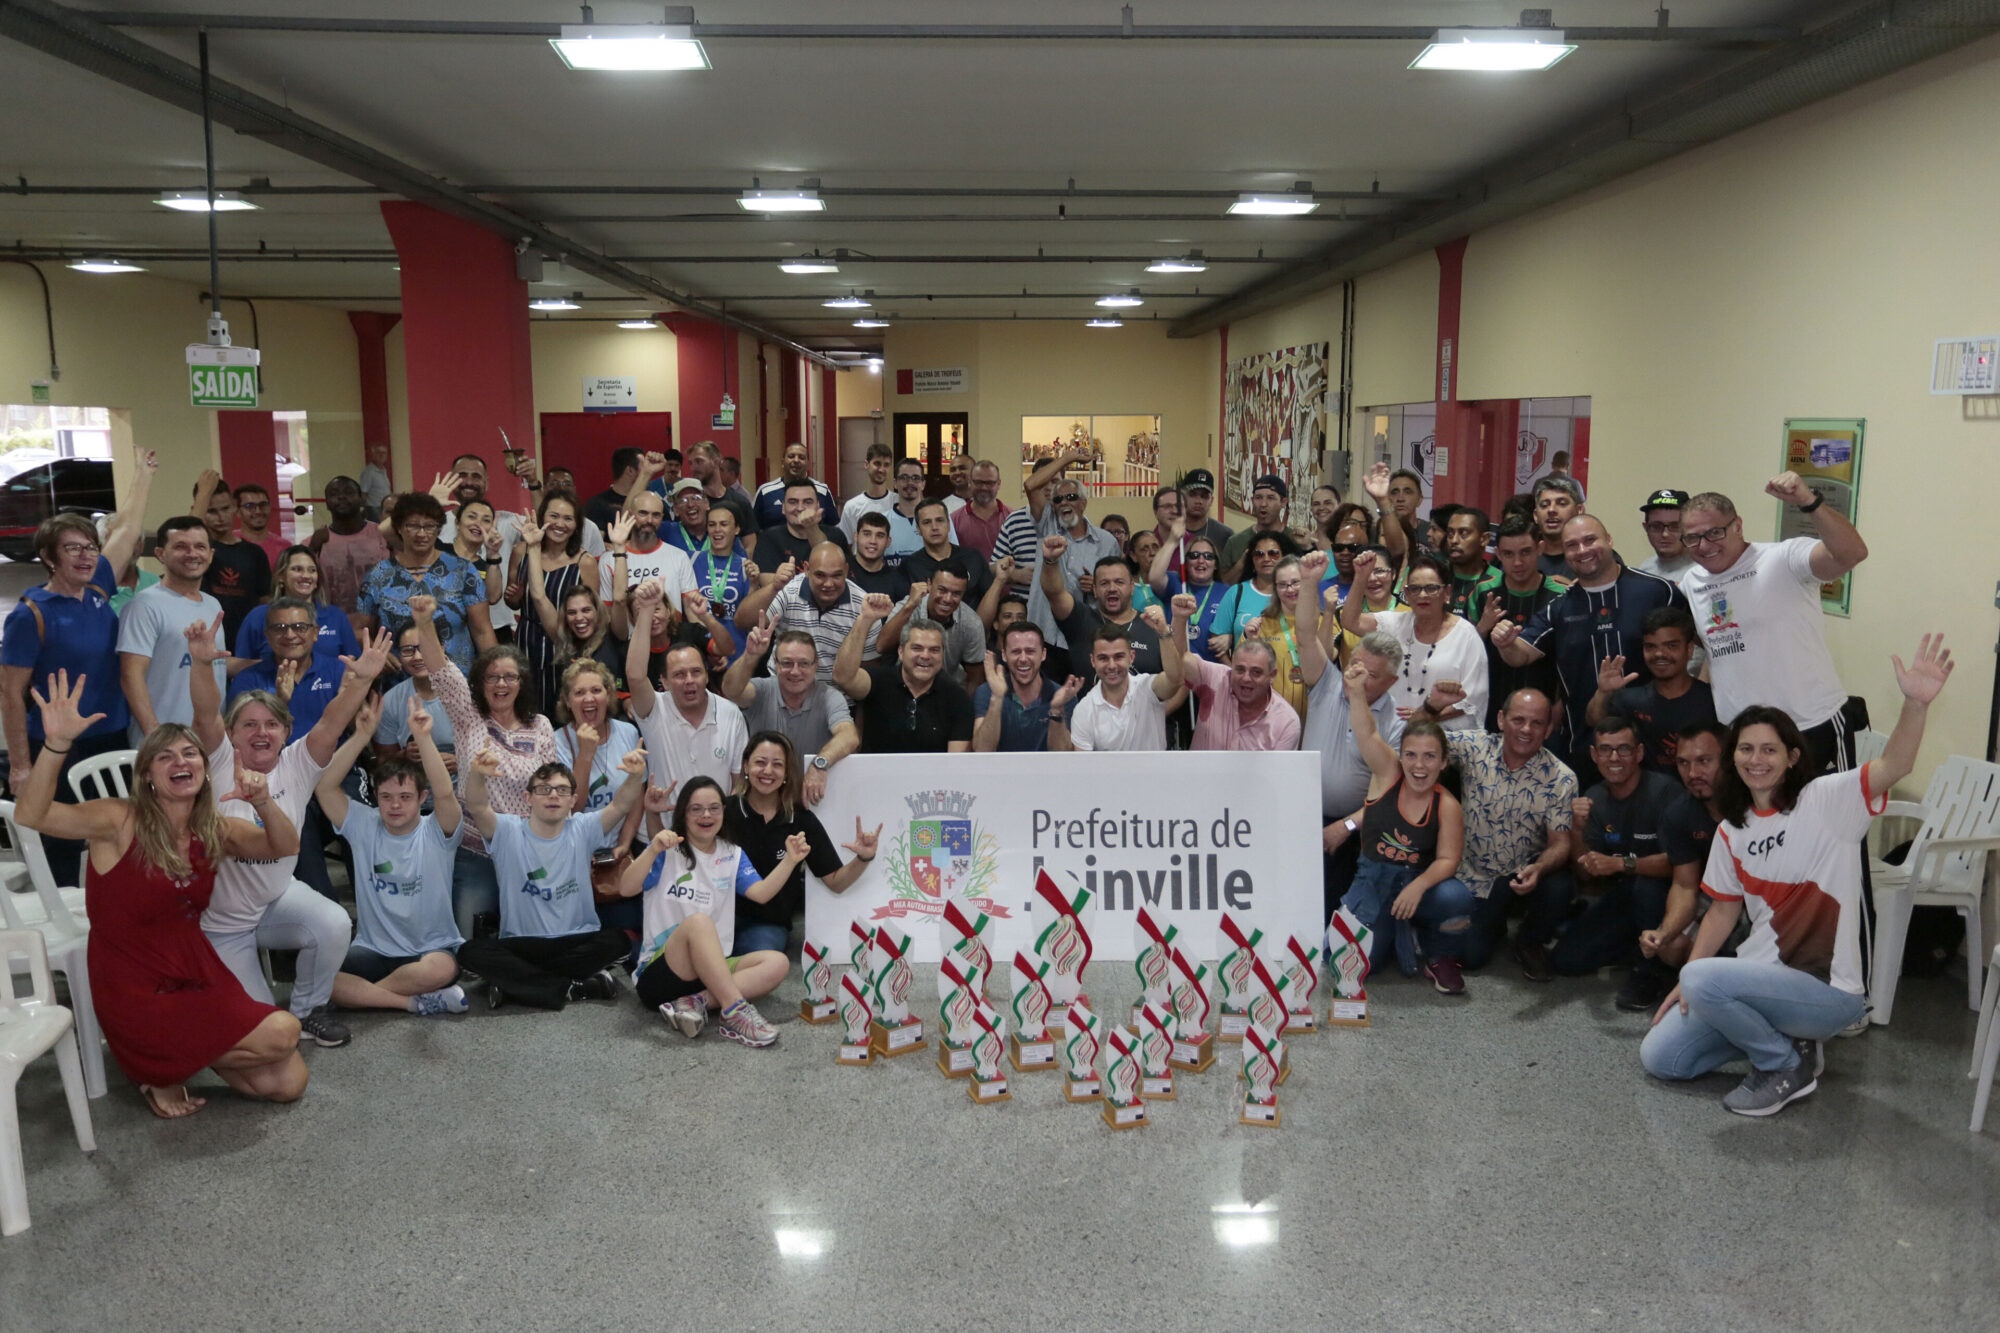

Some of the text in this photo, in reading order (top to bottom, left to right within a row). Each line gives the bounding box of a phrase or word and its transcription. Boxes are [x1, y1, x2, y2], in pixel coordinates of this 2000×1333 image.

[193, 366, 255, 398] SAÍDA
[1710, 641, 1745, 659] Joinville
[1032, 808, 1252, 848] Prefeitura de
[521, 879, 553, 901] APJ
[667, 884, 695, 900] APJ
